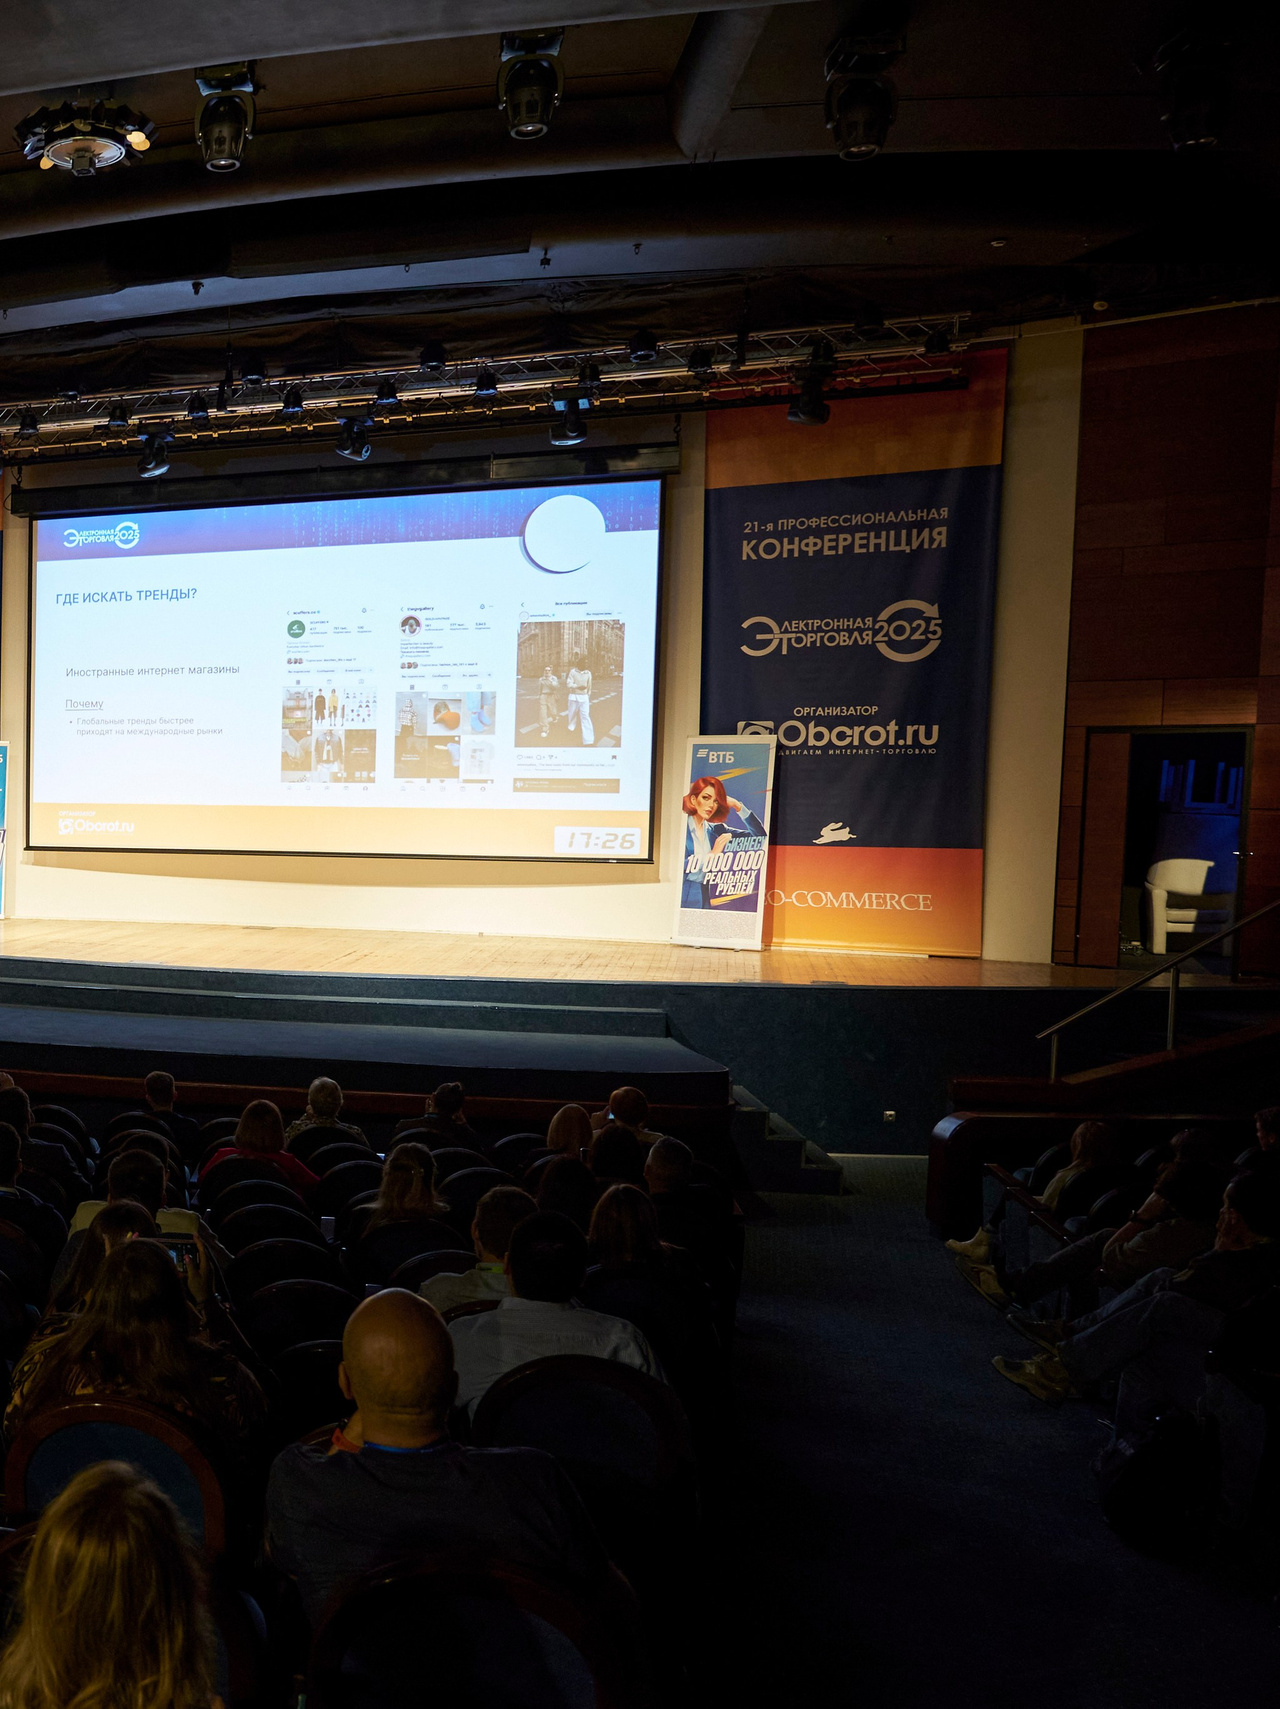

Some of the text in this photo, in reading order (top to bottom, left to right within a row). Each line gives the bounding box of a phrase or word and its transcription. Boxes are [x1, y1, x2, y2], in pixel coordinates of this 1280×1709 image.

[744, 507, 949, 533] 21-я ПРОФЕССИОНАЛЬНАЯ
[114, 530, 140, 540] 2025
[742, 526, 948, 560] КОНФЕРЕНЦИЯ
[56, 588, 197, 606] ГДЕ ИСКАТЬ ТРЕНДЫ?
[873, 620, 943, 641] 2025
[774, 631, 873, 655] ТОРГОВЛЯ
[66, 665, 240, 678] Иностранные интернет магазины
[65, 700, 104, 711] Почему
[794, 705, 879, 717] ОРГАНИЗАТОР
[76, 717, 194, 727] Глобальные тренды быстрее
[76, 728, 113, 737] приходят
[127, 728, 195, 737] международные
[196, 727, 223, 737] рынки
[708, 751, 735, 764] ВТБ
[828, 747, 937, 756] ИНТЕРНЕТ-ТОРГОВЛЮ
[568, 832, 635, 850] 17:26
[686, 850, 765, 874] 10 000 000
[703, 870, 758, 885] РЕАЛЬНЫХ
[716, 882, 755, 895] РУБЛЕЙ
[764, 889, 933, 911] O-COMMERCE
